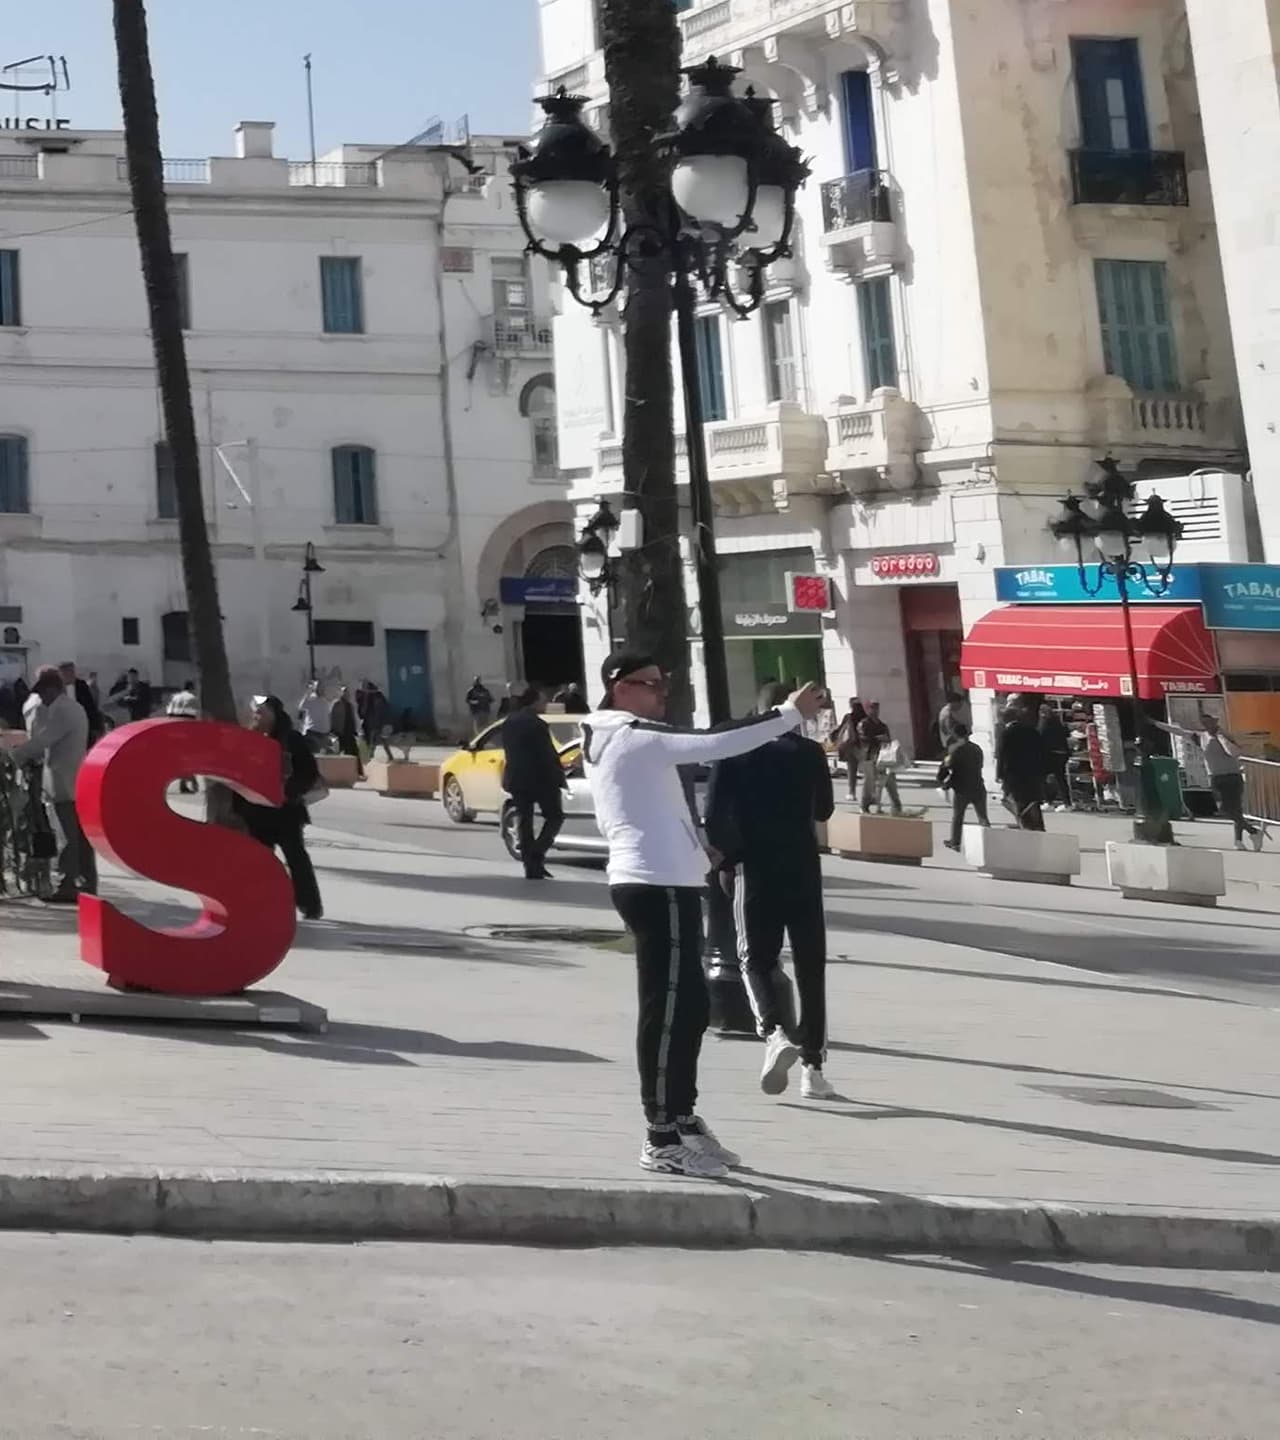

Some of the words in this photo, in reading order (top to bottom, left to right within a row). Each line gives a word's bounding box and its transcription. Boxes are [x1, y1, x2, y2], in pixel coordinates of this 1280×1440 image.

[872, 554, 934, 572] ooredoo
[1015, 570, 1055, 586] TABAC
[1159, 681, 1206, 692] TABAC
